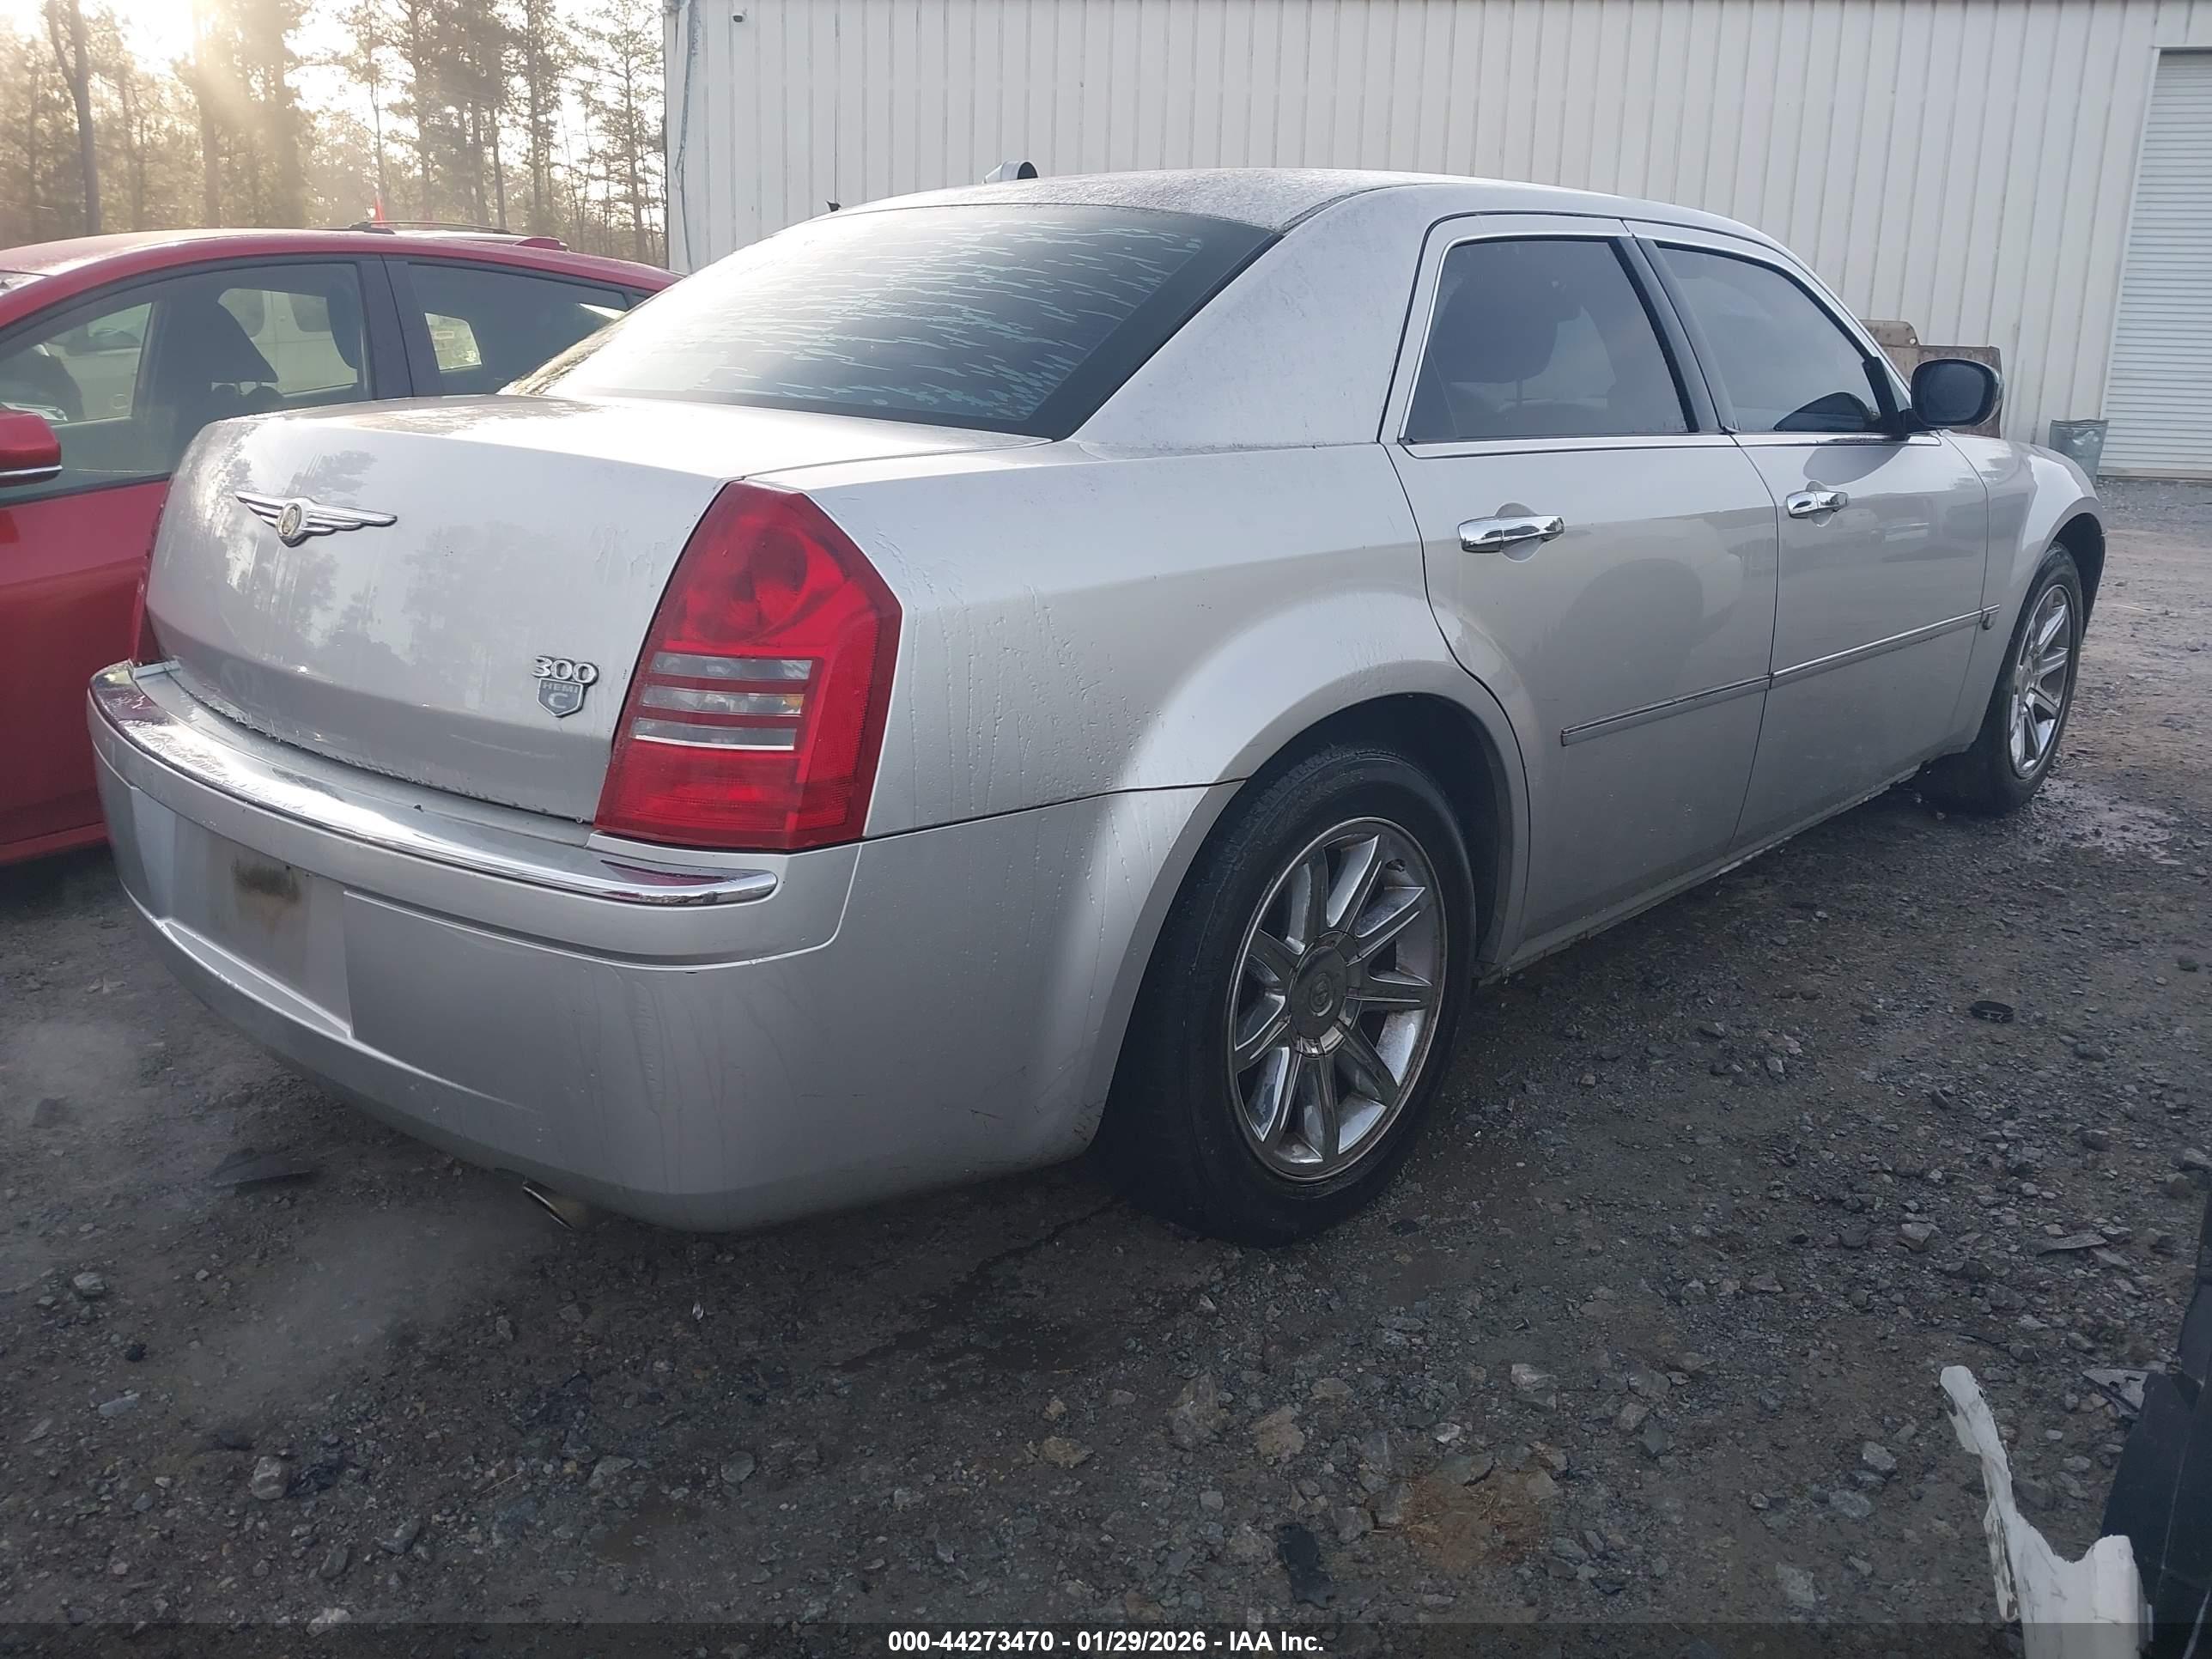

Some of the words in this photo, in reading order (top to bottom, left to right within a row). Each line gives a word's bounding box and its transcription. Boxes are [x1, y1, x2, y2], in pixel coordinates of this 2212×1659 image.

[532, 655, 599, 684] 300
[543, 682, 578, 694] HEMI
[548, 692, 568, 709] C
